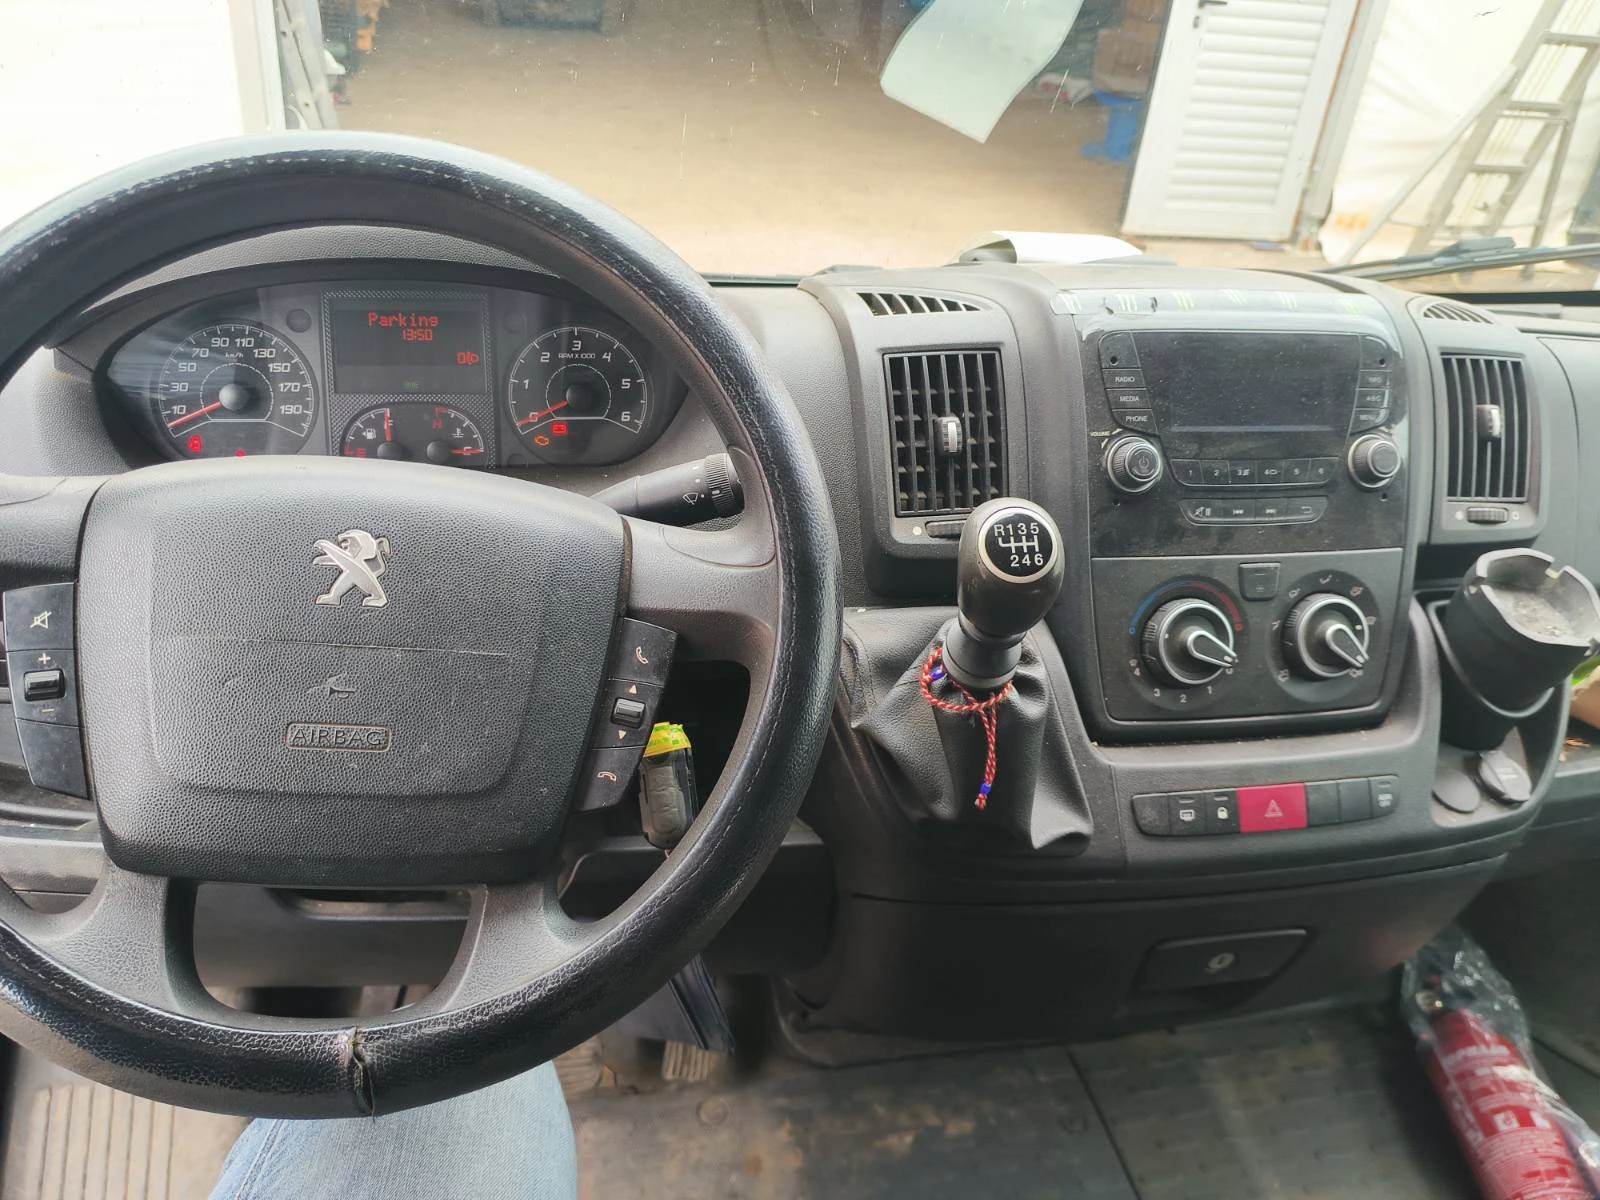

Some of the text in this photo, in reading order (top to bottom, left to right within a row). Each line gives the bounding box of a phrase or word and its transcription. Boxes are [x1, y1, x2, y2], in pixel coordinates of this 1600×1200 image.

[402, 329, 433, 341] 13:50
[211, 338, 229, 347] 90
[235, 338, 254, 347] 110
[572, 341, 582, 351] 3
[191, 348, 209, 358] 70
[253, 348, 276, 358] 130
[540, 352, 550, 362] 2
[602, 352, 612, 362] 4
[178, 363, 197, 372] 50
[268, 363, 291, 372] 150
[170, 382, 189, 392] 30
[278, 383, 300, 392] 170
[523, 379, 530, 389] 1
[621, 379, 631, 389] 5
[171, 405, 186, 414] 10
[280, 405, 302, 414] 190
[621, 412, 631, 422] 6
[1134, 667, 1140, 676] 4
[1153, 689, 1161, 697] 3
[1206, 686, 1212, 695] 1
[1180, 694, 1187, 703] 2
[292, 728, 382, 746] AIRBAG
